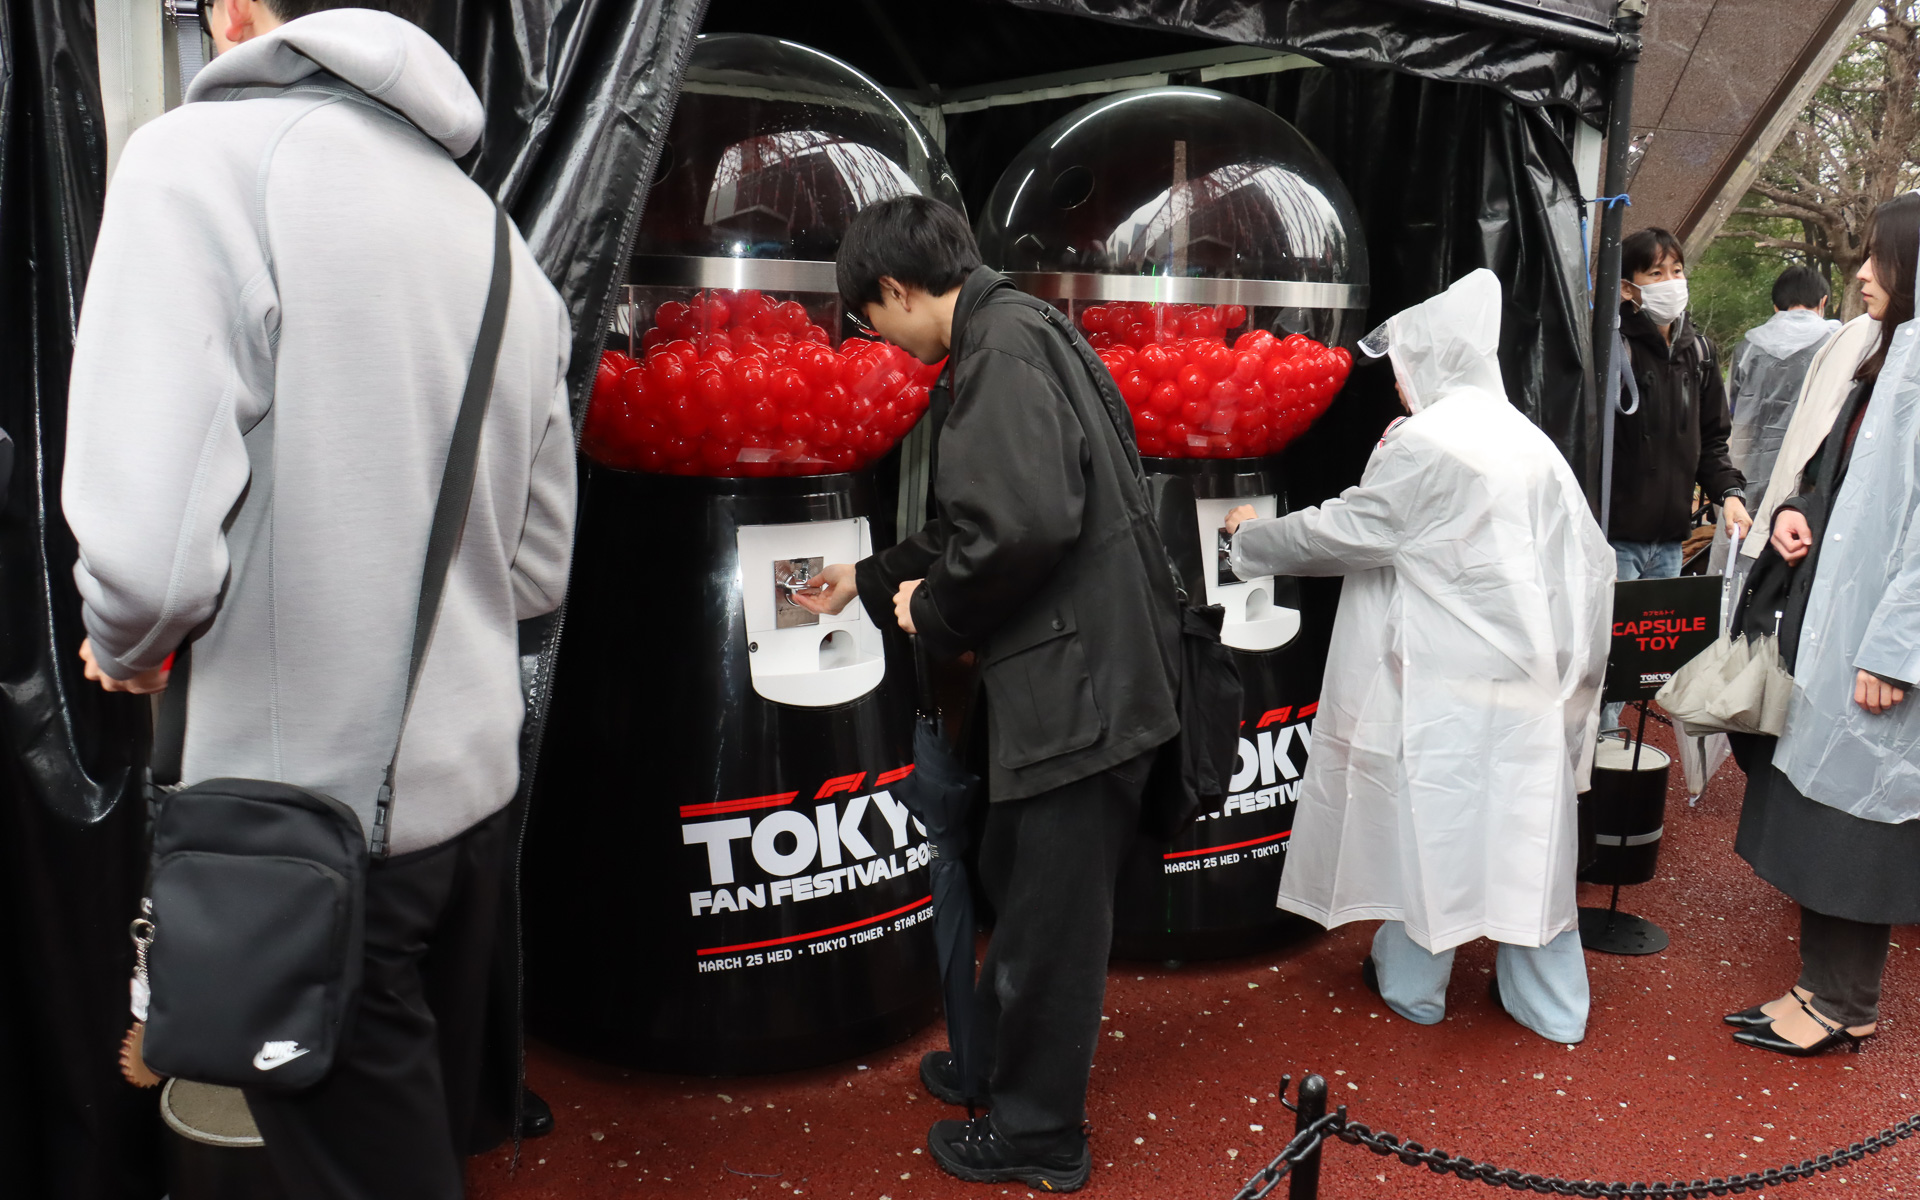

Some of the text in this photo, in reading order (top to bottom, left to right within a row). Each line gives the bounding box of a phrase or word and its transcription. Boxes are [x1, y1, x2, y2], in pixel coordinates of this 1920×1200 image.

[1612, 617, 1706, 636] CAPSULE
[1636, 636, 1680, 651] TOY
[1640, 673, 1672, 681] TOKYO
[1224, 779, 1303, 817] FESTIV
[682, 790, 927, 886] TOKY
[1164, 860, 1201, 874] MARCH
[1203, 858, 1218, 868] 25
[1220, 854, 1240, 865] WED
[1251, 844, 1280, 859] TOKYO
[690, 842, 931, 916] FAN FESTIVAL 20
[698, 958, 742, 973] MARCH
[746, 954, 763, 967] 25
[767, 949, 793, 963] WED
[808, 937, 847, 955] TOKYO
[850, 927, 884, 945] TOWER
[894, 915, 917, 931] STAR
